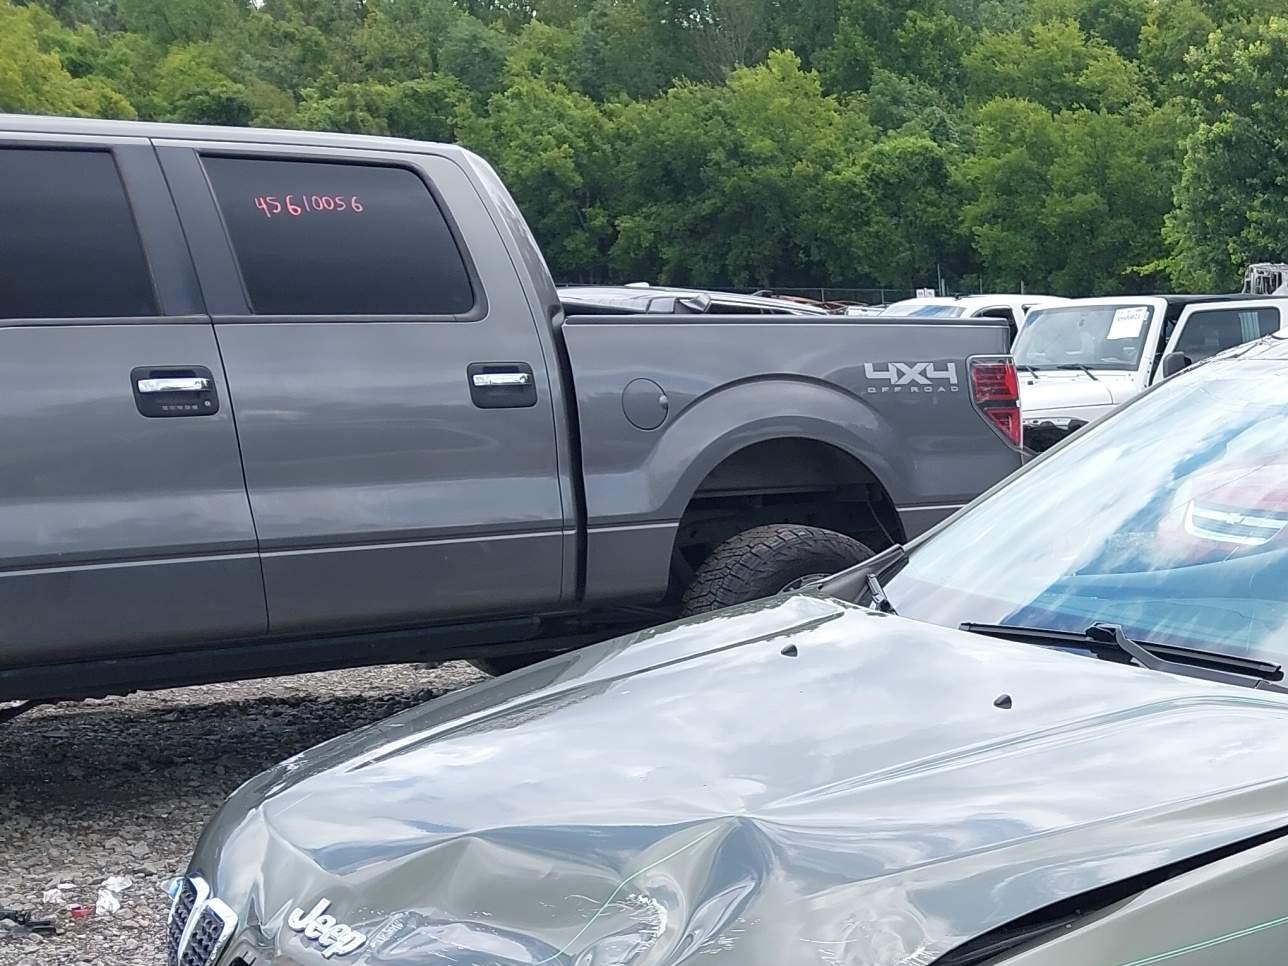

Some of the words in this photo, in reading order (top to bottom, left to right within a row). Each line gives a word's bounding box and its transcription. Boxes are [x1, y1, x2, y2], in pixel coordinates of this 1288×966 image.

[255, 194, 363, 218] 45610056
[863, 362, 958, 385] 4X4
[287, 897, 367, 960] Jeep
